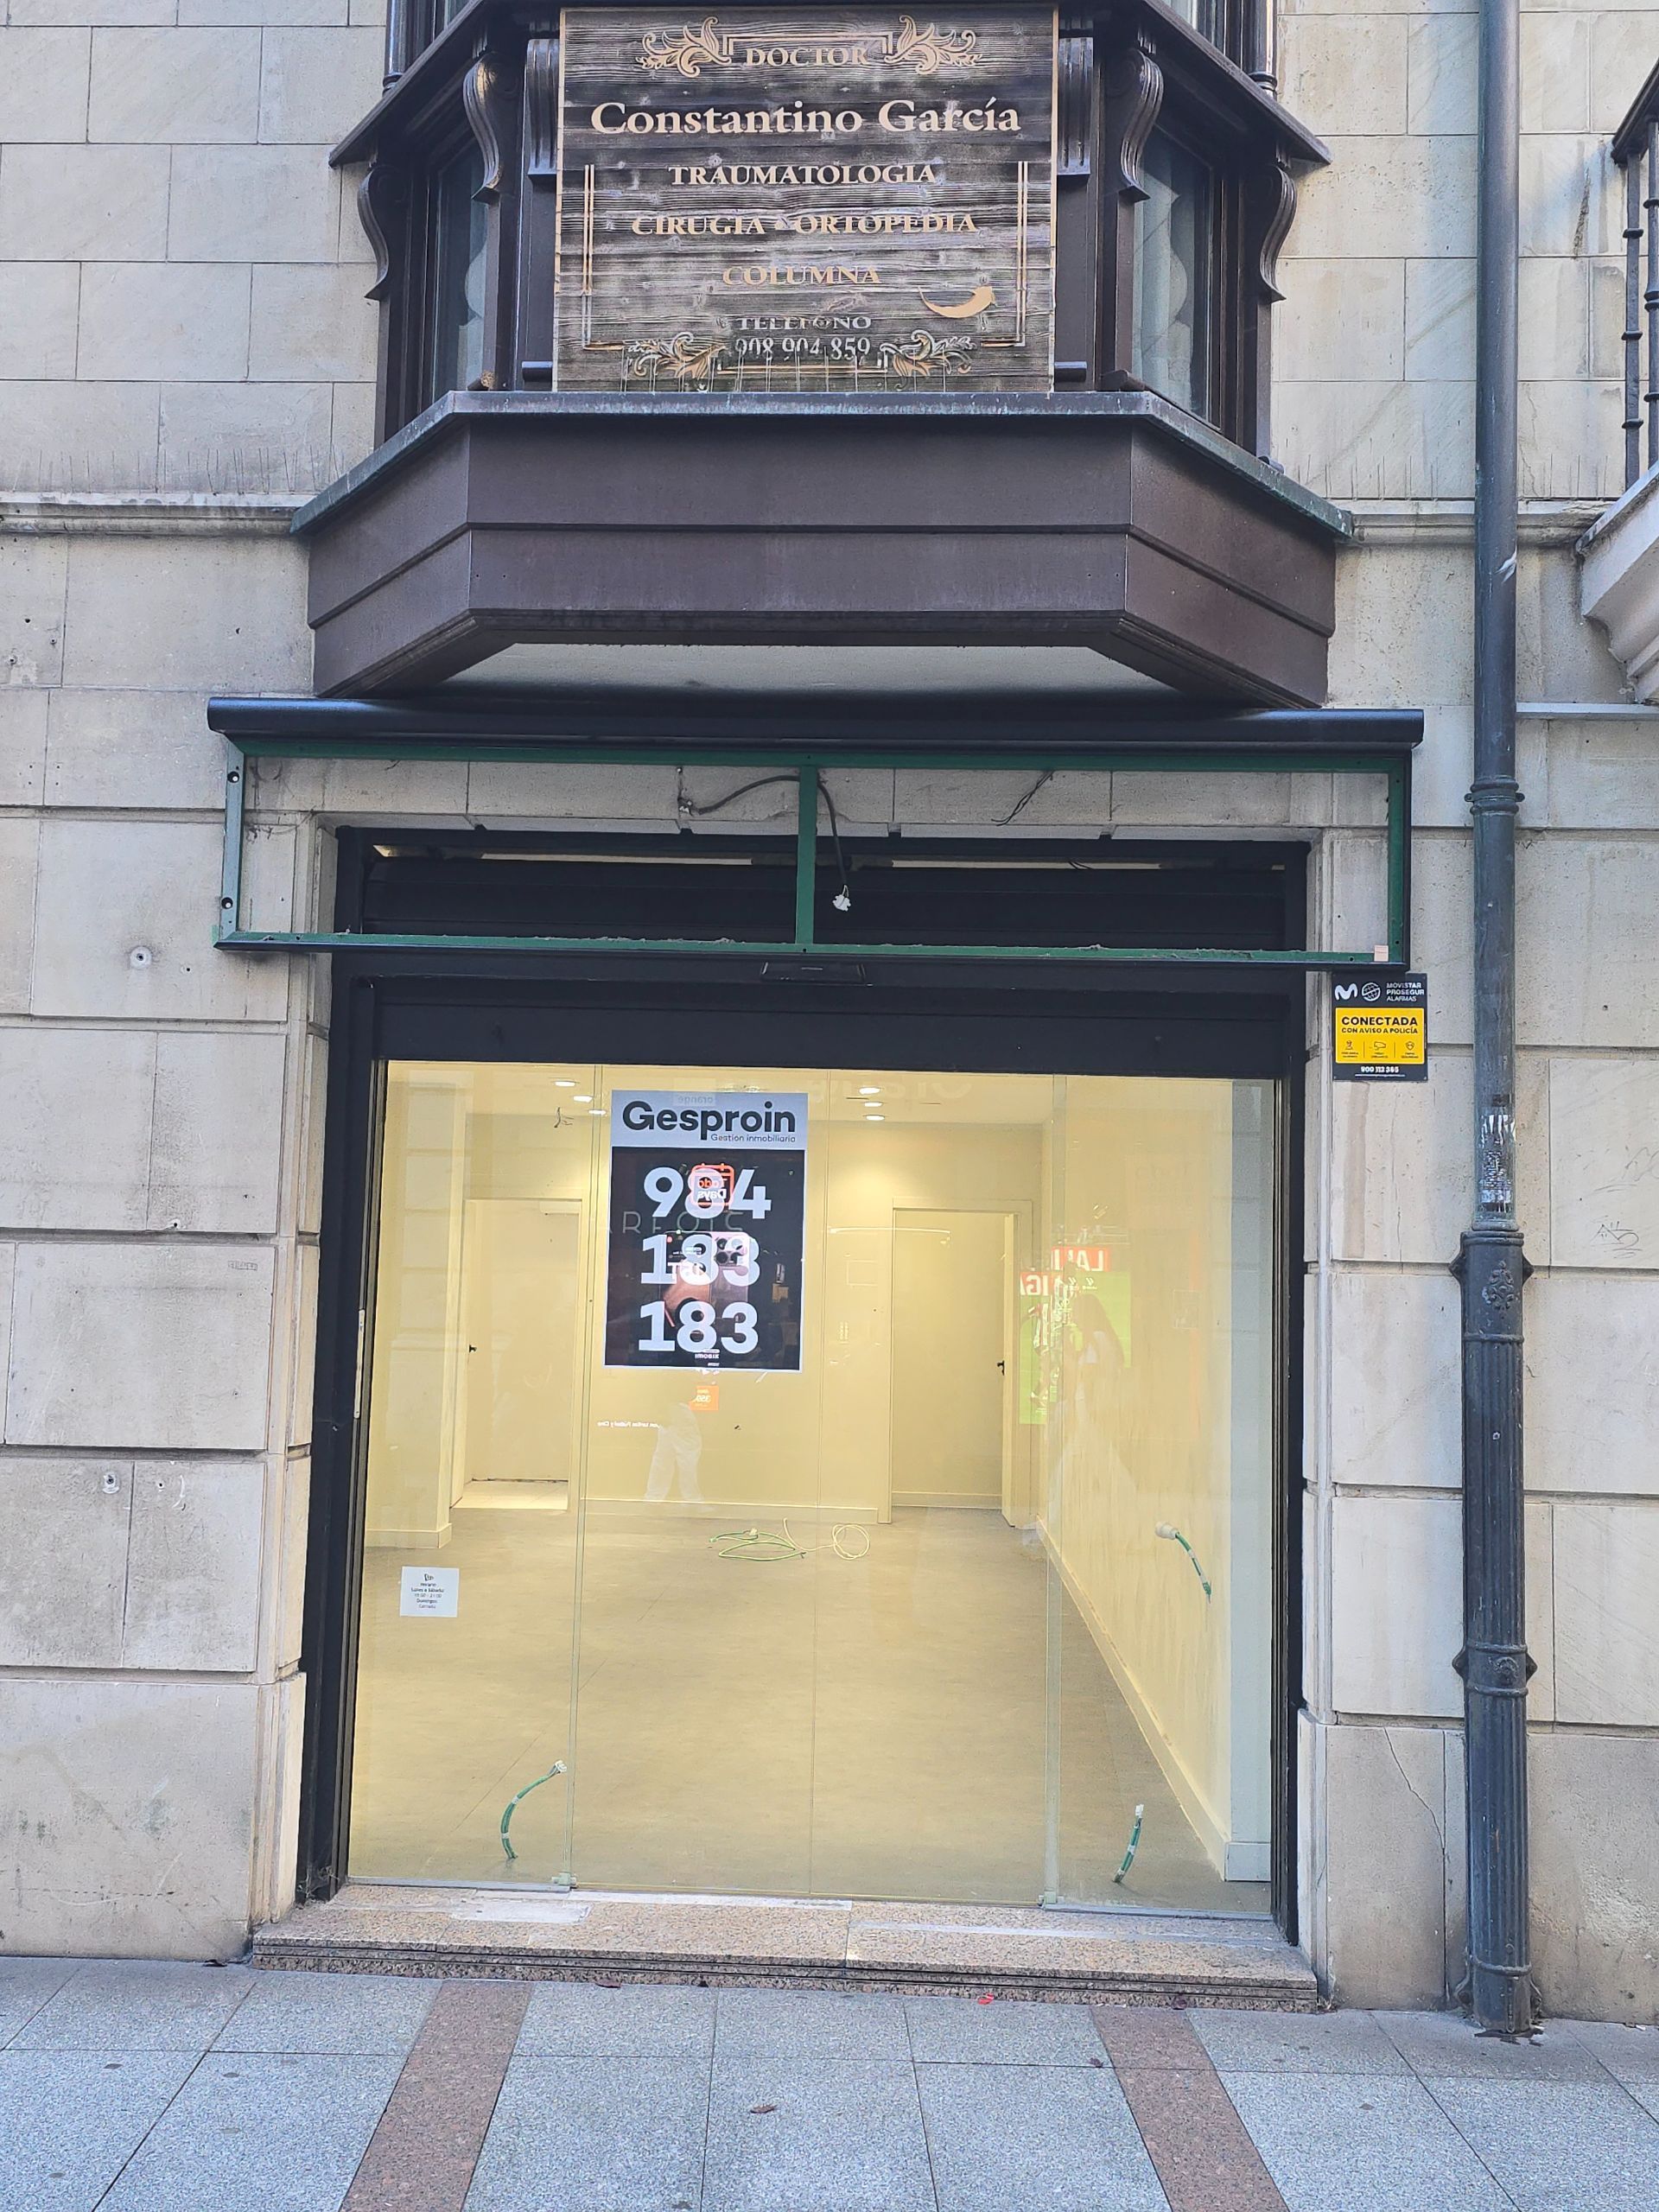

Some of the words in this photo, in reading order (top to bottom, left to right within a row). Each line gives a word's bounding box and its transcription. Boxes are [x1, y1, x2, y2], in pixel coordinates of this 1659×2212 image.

[744, 46, 868, 67] DOCTOR
[591, 101, 862, 135] Constantino
[878, 96, 1021, 133] García
[668, 164, 937, 186] TRAUMATOLOGIA
[631, 215, 766, 236] CIRUGIA
[794, 213, 978, 234] ORTOPEDIA
[721, 265, 882, 285] COLUMNA
[830, 337, 872, 361] 859
[1341, 1016, 1419, 1026] CONECTADA
[621, 1100, 796, 1141] Gesproin
[746, 1133, 796, 1143] inmobiliaria
[642, 1166, 772, 1220] 984
[639, 1234, 761, 1287] 183
[638, 1300, 759, 1354] 183
